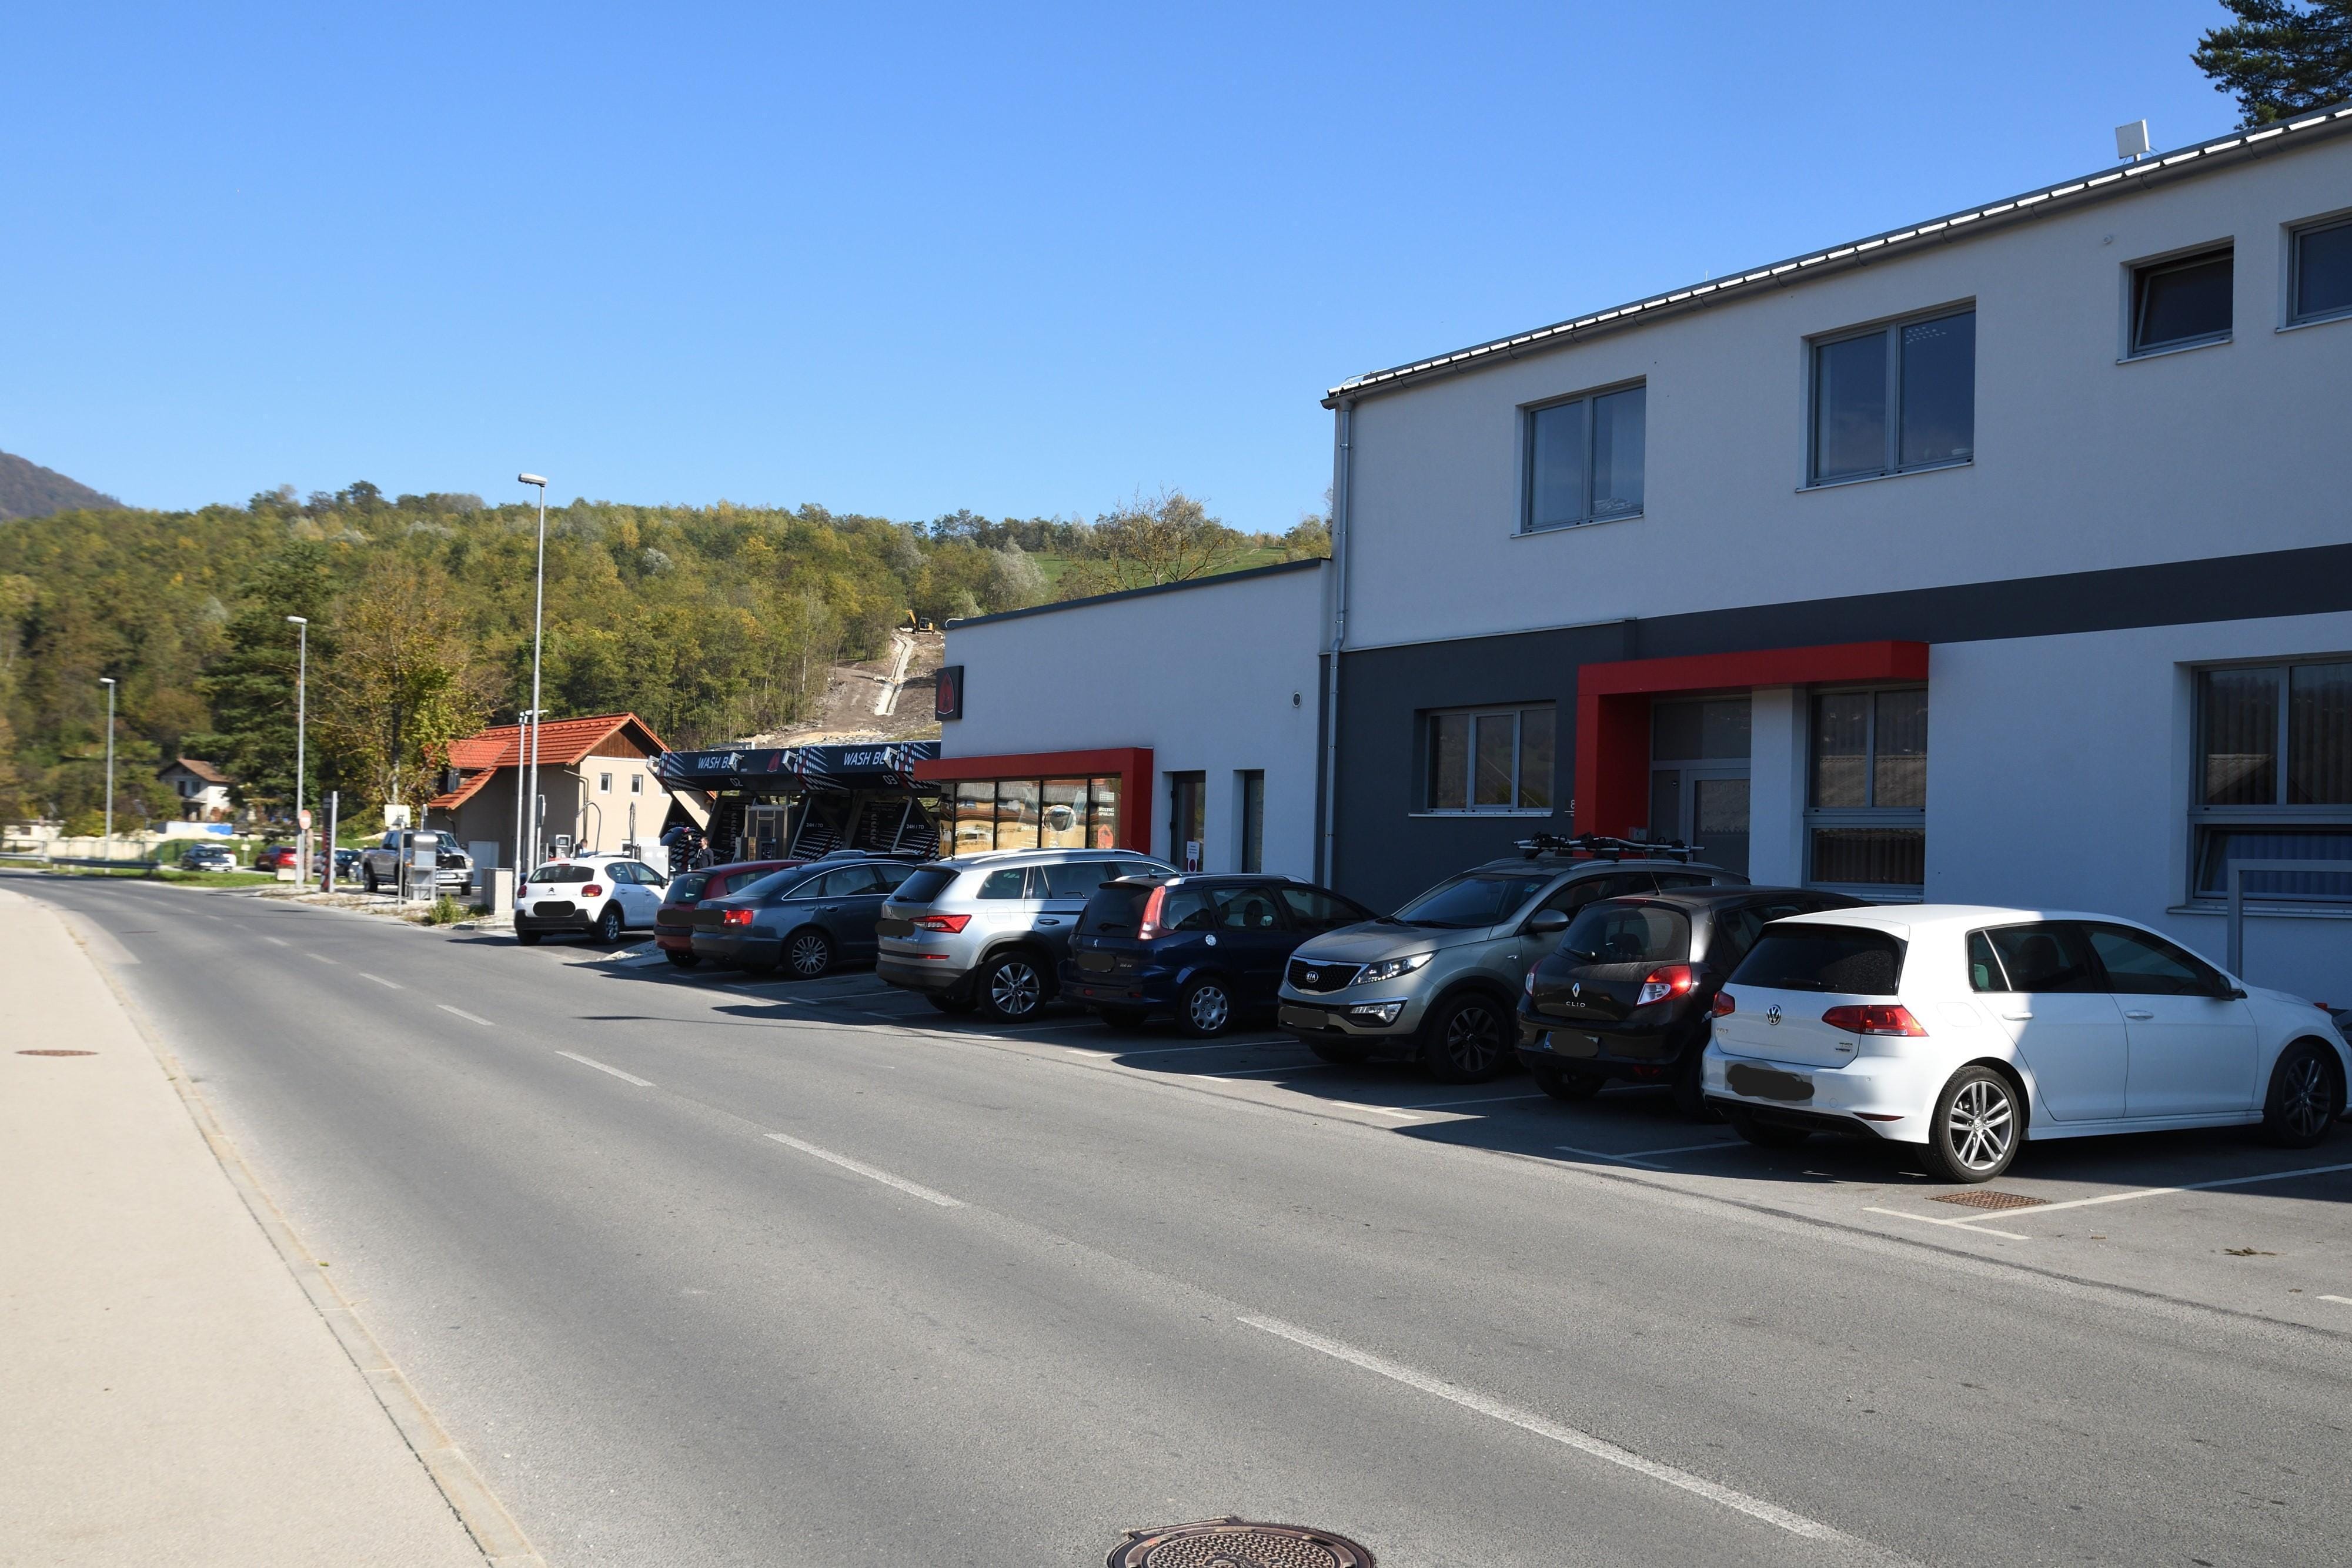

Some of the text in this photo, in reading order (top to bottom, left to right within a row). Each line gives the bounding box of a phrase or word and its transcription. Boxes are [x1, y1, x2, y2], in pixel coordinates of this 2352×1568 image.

[697, 757, 721, 769] WASH
[844, 752, 872, 765] WASH
[729, 778, 744, 787] 02
[883, 775, 898, 785] 03
